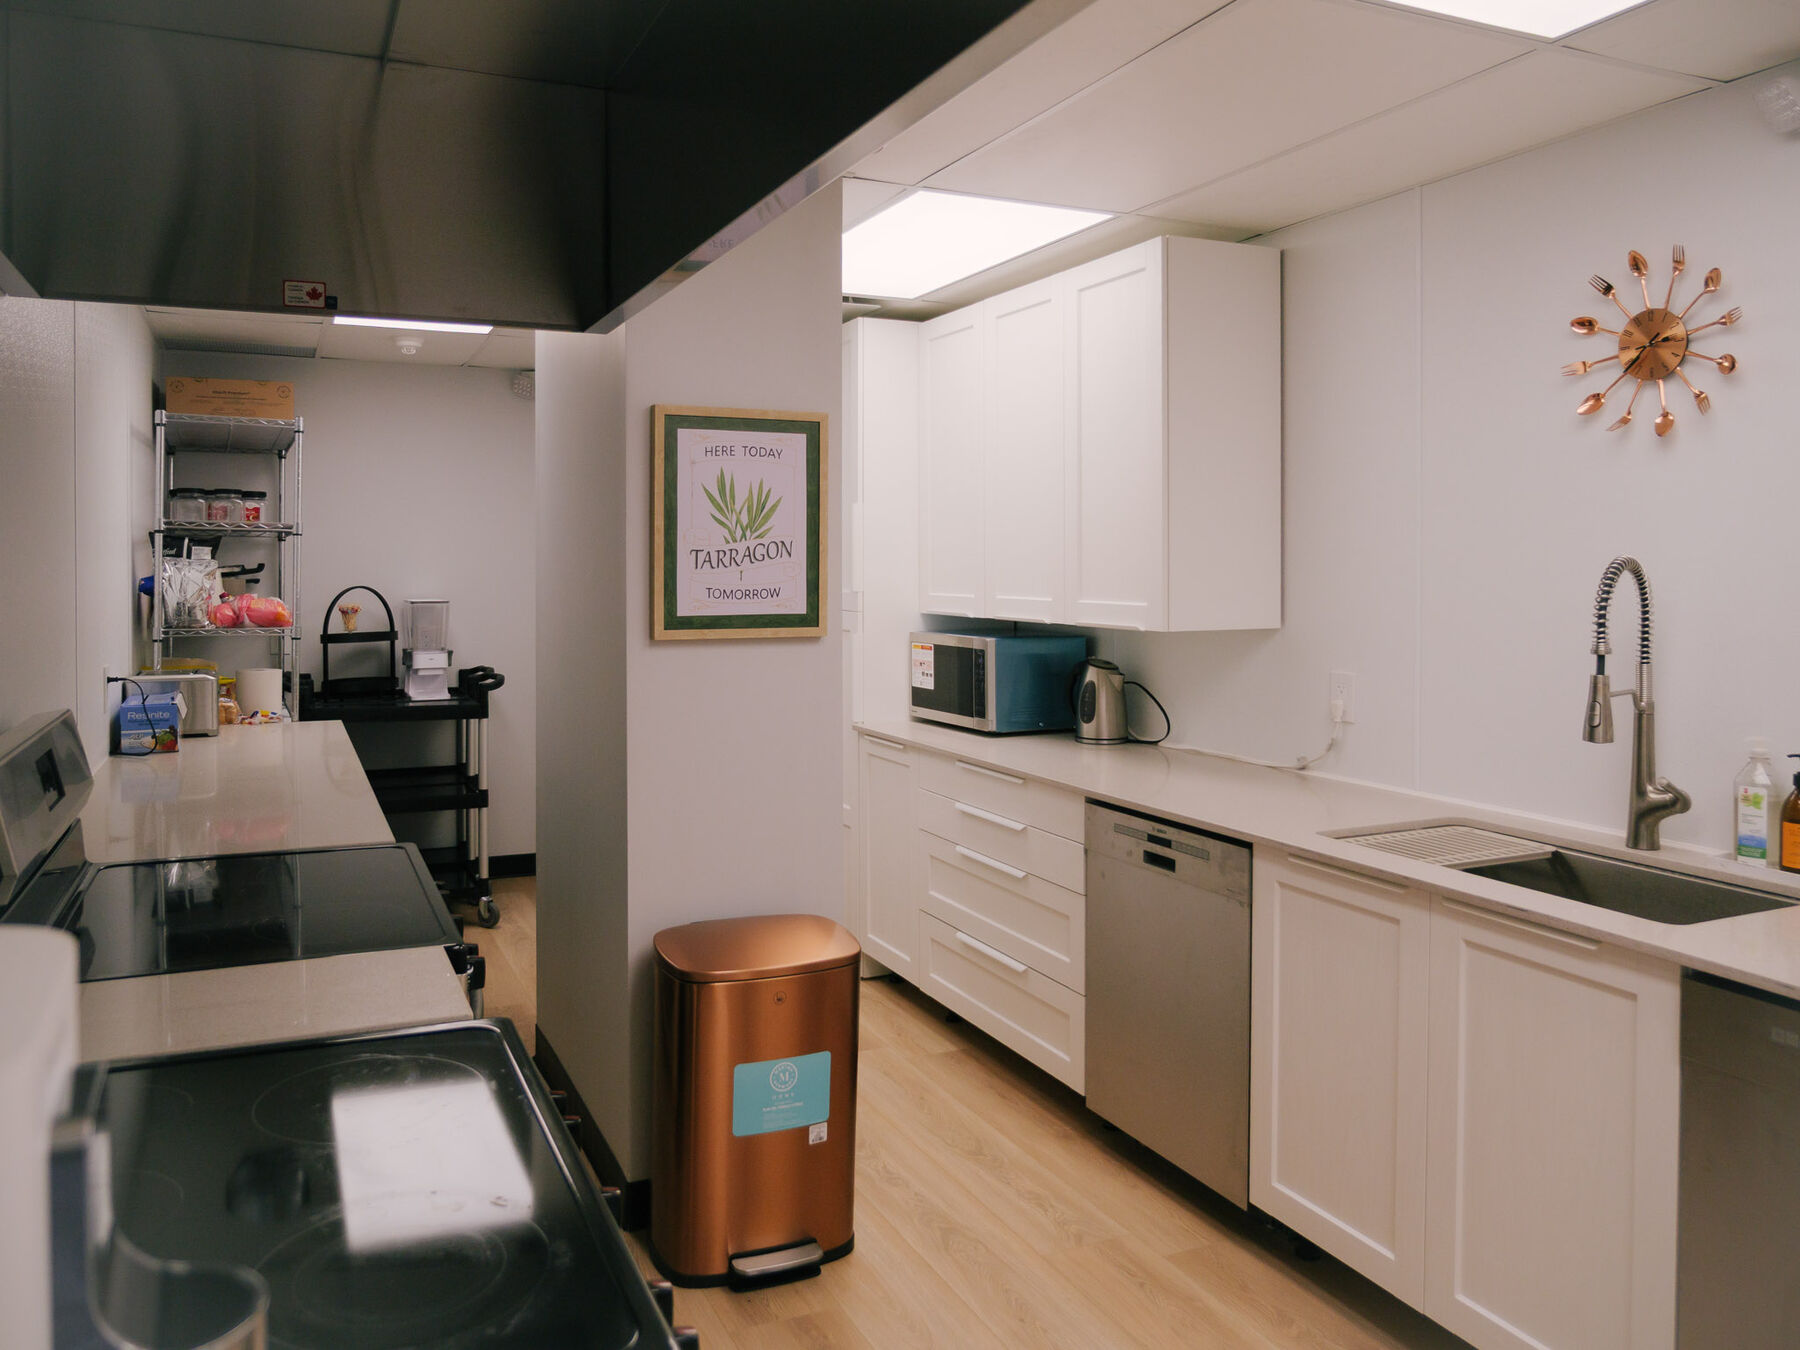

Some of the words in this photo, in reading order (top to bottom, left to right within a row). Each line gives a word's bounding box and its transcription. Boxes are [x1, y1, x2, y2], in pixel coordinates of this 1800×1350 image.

[704, 445, 736, 457] HERE
[742, 446, 783, 459] TODAY
[690, 540, 793, 570] TARRAGON
[706, 587, 781, 600] TOMORROW
